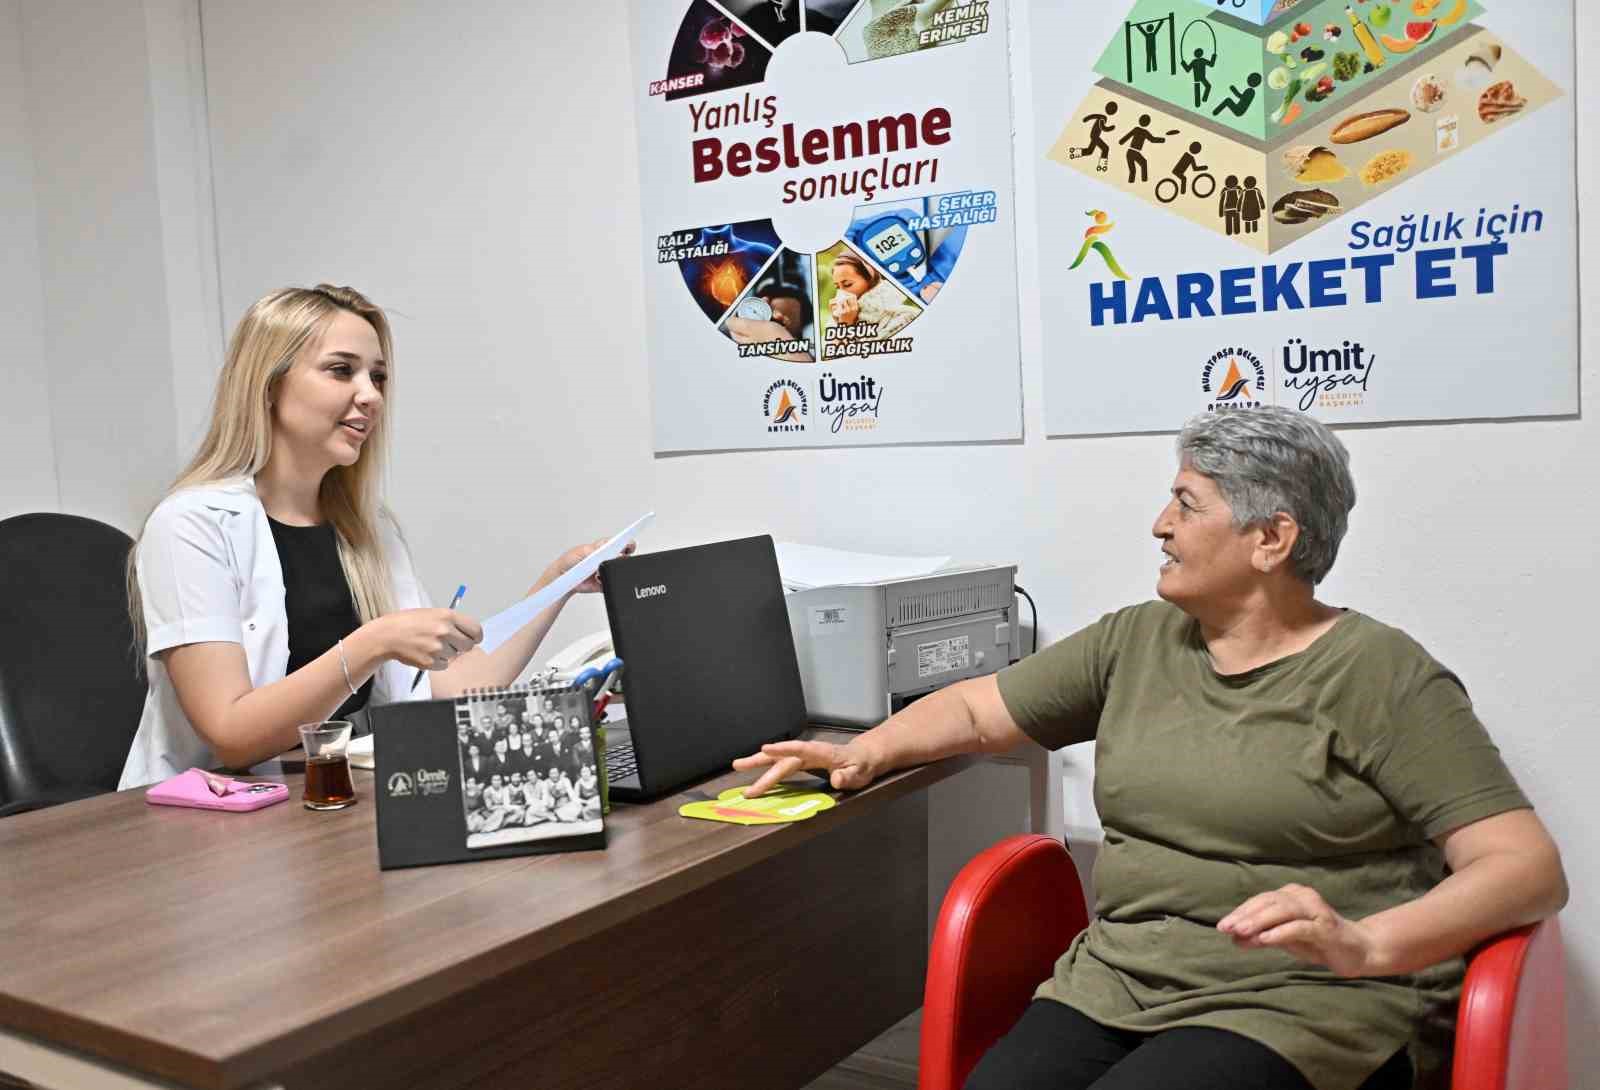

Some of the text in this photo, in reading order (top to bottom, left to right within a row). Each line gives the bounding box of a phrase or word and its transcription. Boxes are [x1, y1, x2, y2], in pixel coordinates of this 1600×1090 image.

[933, 1, 989, 26] KEMİK
[919, 15, 988, 45] ERİMESİ
[649, 73, 705, 95] KANSER
[688, 94, 777, 132] Yanlış
[692, 106, 951, 184] Beslenme
[782, 158, 939, 204] sonuçları
[939, 192, 996, 213] ŞEKER
[908, 206, 996, 231] HASTALIĞI
[1348, 204, 1544, 253] Sağlık için
[658, 233, 694, 249] KALP
[658, 240, 729, 263] HASTALIĞI
[875, 235, 900, 254] 102
[1089, 242, 1508, 327] HAREKET ET
[738, 339, 810, 357] TANSİYON
[825, 338, 913, 358] BAĞIŞIKLIK
[1282, 338, 1365, 374] Ümit
[820, 372, 876, 402] Ümit
[634, 584, 667, 599] Lenovo
